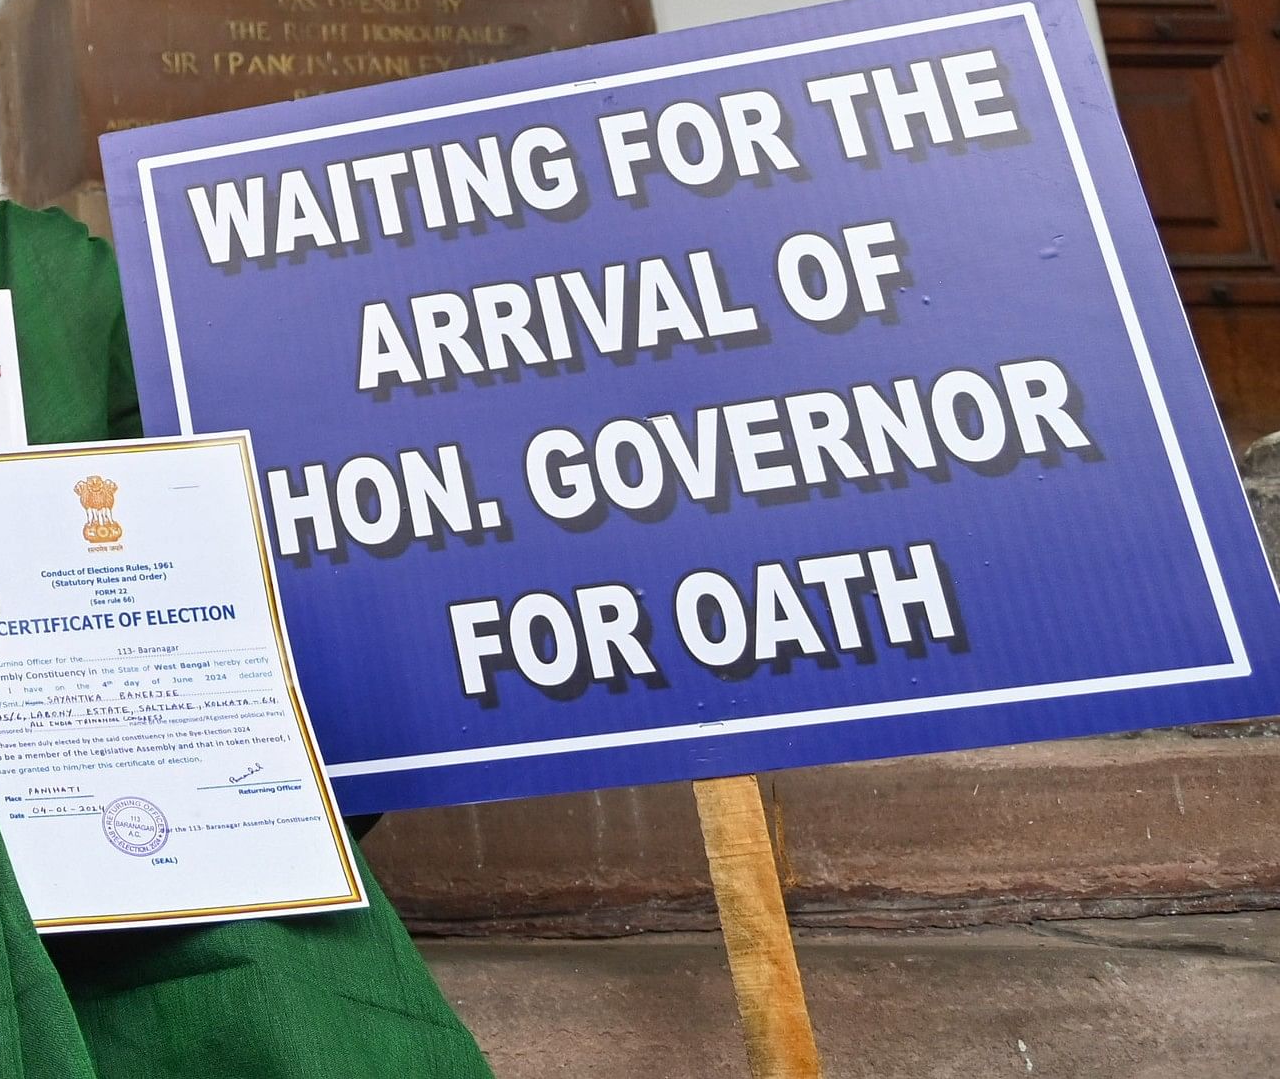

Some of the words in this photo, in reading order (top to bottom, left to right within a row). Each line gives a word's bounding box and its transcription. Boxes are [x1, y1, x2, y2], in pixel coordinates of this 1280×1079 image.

[226, 21, 271, 42] THE
[161, 52, 198, 75] SIR
[187, 126, 575, 264] WAITING
[599, 92, 799, 196] FOR
[807, 50, 1018, 157] THE
[360, 252, 757, 389] ARRIVAL
[778, 222, 899, 320] OF
[268, 446, 500, 554] HON.
[527, 361, 1090, 518] GOVERNOR
[41, 569, 76, 578] Conduct
[87, 566, 124, 575] Elections
[153, 562, 174, 570] 1961
[51, 579, 94, 589] (Statutory
[96, 576, 120, 584] Rules
[122, 574, 137, 582] and
[139, 572, 167, 581] Order)
[118, 611, 142, 627] OF
[146, 604, 236, 626] ELECTION
[450, 590, 655, 693] FOR
[677, 545, 954, 665] OATH
[117, 647, 135, 655] 113-
[138, 645, 179, 654] Baranagar
[25, 670, 86, 679] Constituency
[118, 666, 139, 674] State
[180, 660, 210, 669] Bengal
[214, 659, 241, 667] hereby
[244, 656, 269, 664] certify
[25, 751, 60, 759] member
[62, 749, 71, 757] of
[73, 749, 88, 757] the
[90, 747, 134, 756] Legislative
[136, 743, 176, 752] Assembly
[178, 742, 194, 750] and
[226, 738, 250, 746] token
[252, 734, 286, 744] thereof,
[238, 787, 276, 795] Returning
[151, 857, 178, 866] (SEAL)
